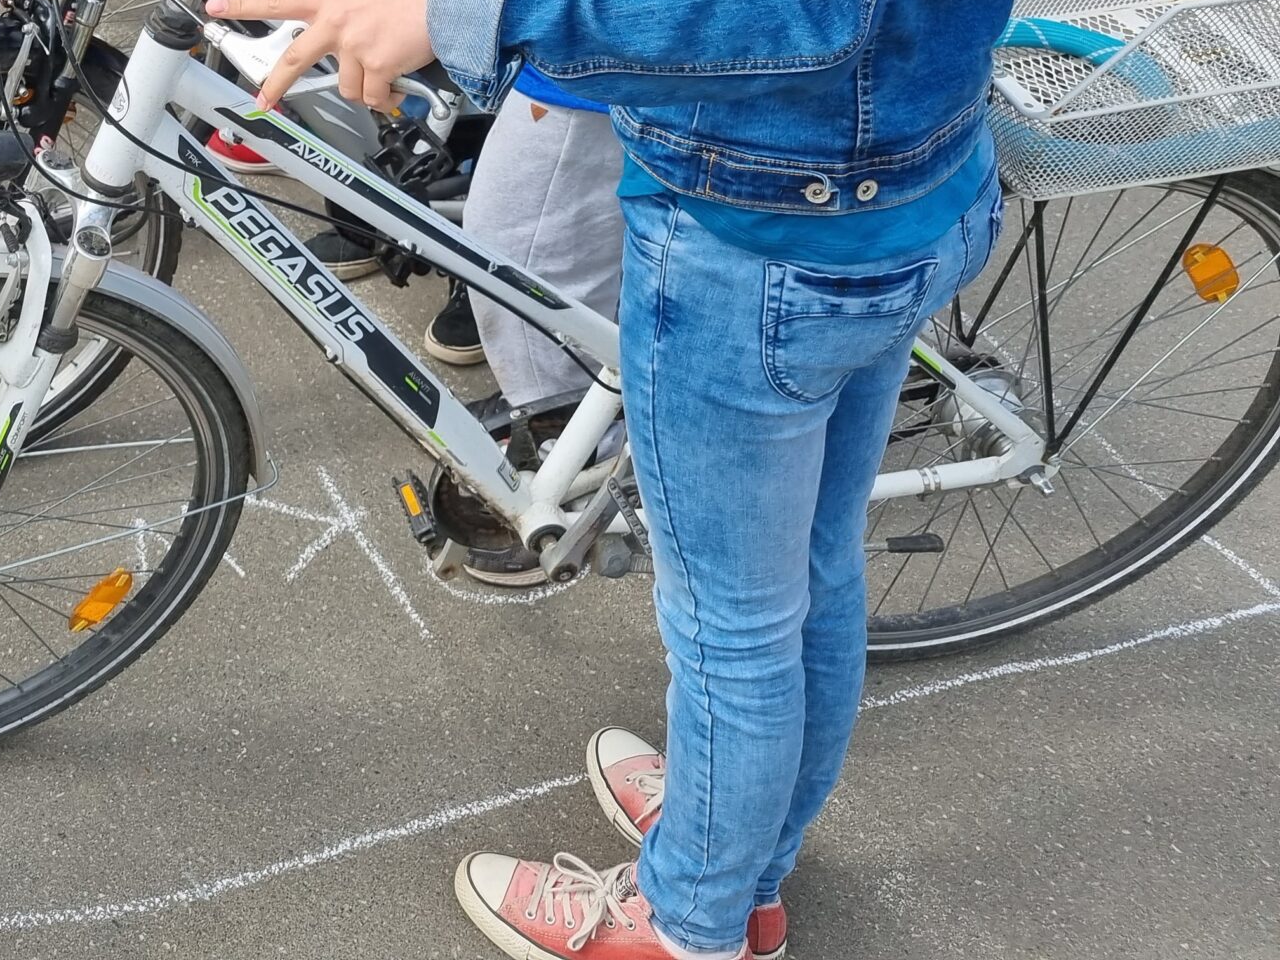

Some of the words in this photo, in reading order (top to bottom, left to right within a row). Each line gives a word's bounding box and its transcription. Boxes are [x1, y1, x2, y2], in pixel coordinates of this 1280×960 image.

[288, 141, 355, 186] AVANTI
[203, 186, 379, 343] PEGASUS
[408, 371, 431, 393] AVANTI
[10, 411, 29, 445] COMFORT
